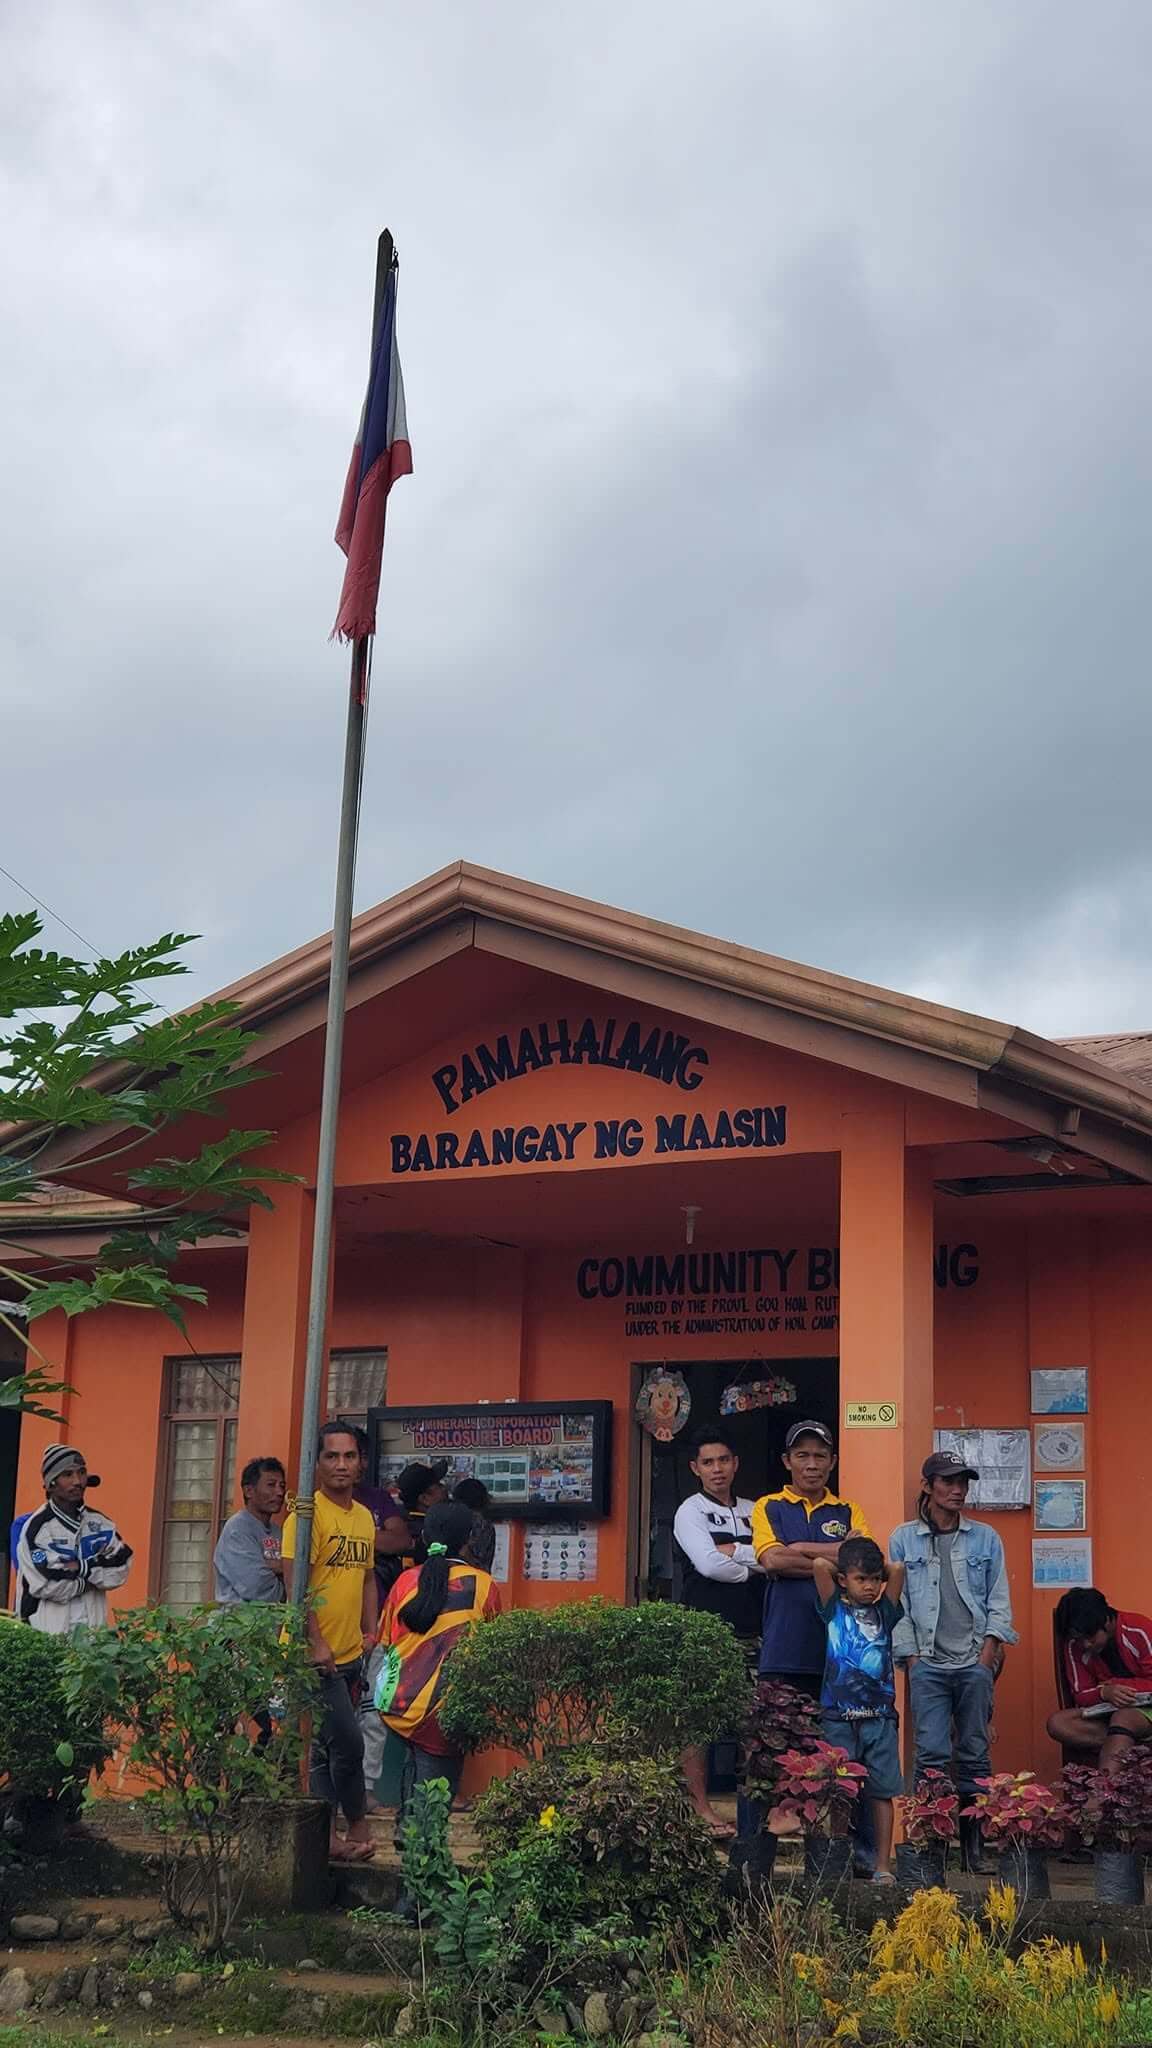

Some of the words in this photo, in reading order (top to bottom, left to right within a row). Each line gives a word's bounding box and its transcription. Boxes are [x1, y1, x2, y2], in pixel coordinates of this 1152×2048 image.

[432, 1018, 710, 1115] PAMAHALAANG
[391, 1121, 587, 1173] BARANGAY
[594, 1118, 644, 1159] NG
[654, 1106, 787, 1153] MAASIN
[577, 1249, 798, 1299] COMMUNITY
[625, 1300, 667, 1315] FUNDED
[671, 1299, 684, 1315] BY
[688, 1299, 706, 1313] THE
[625, 1320, 659, 1336] UNDER
[663, 1320, 681, 1334] THE
[684, 1317, 766, 1335] ADMINISTRATION
[768, 1316, 780, 1332] OF
[849, 1413, 876, 1422] SMOKING
[858, 1405, 867, 1413] NO
[480, 1415, 561, 1429] CORPORATION
[415, 1428, 499, 1447] DISCLOSURE
[503, 1427, 552, 1446] BOARD
